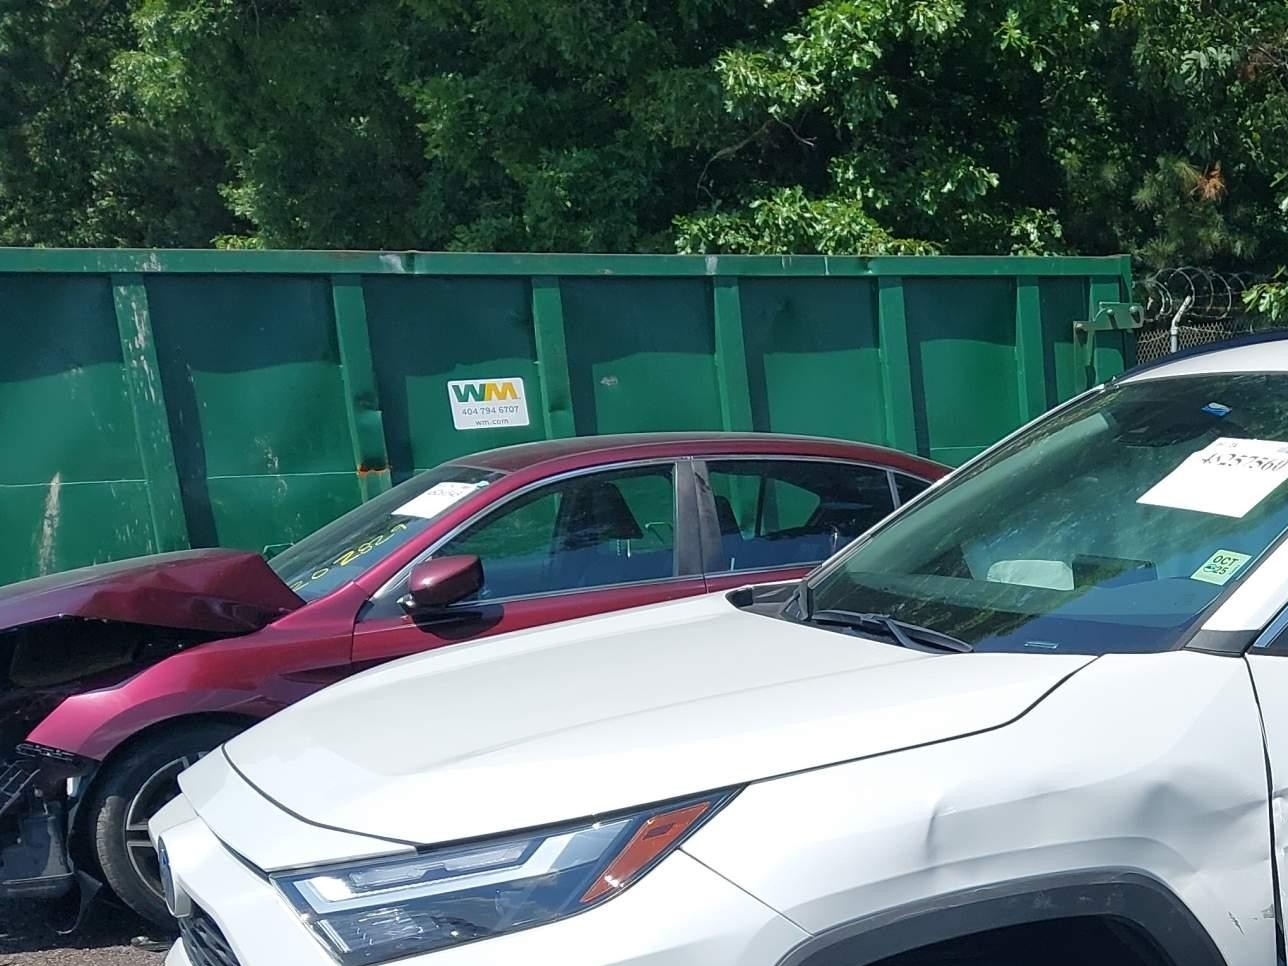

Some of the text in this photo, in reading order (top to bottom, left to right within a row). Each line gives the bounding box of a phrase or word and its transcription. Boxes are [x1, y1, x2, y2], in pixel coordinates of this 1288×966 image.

[452, 382, 519, 402] WM
[462, 405, 519, 416] 404 794 6707
[475, 418, 509, 426] wm.com
[1213, 555, 1240, 567] OCT
